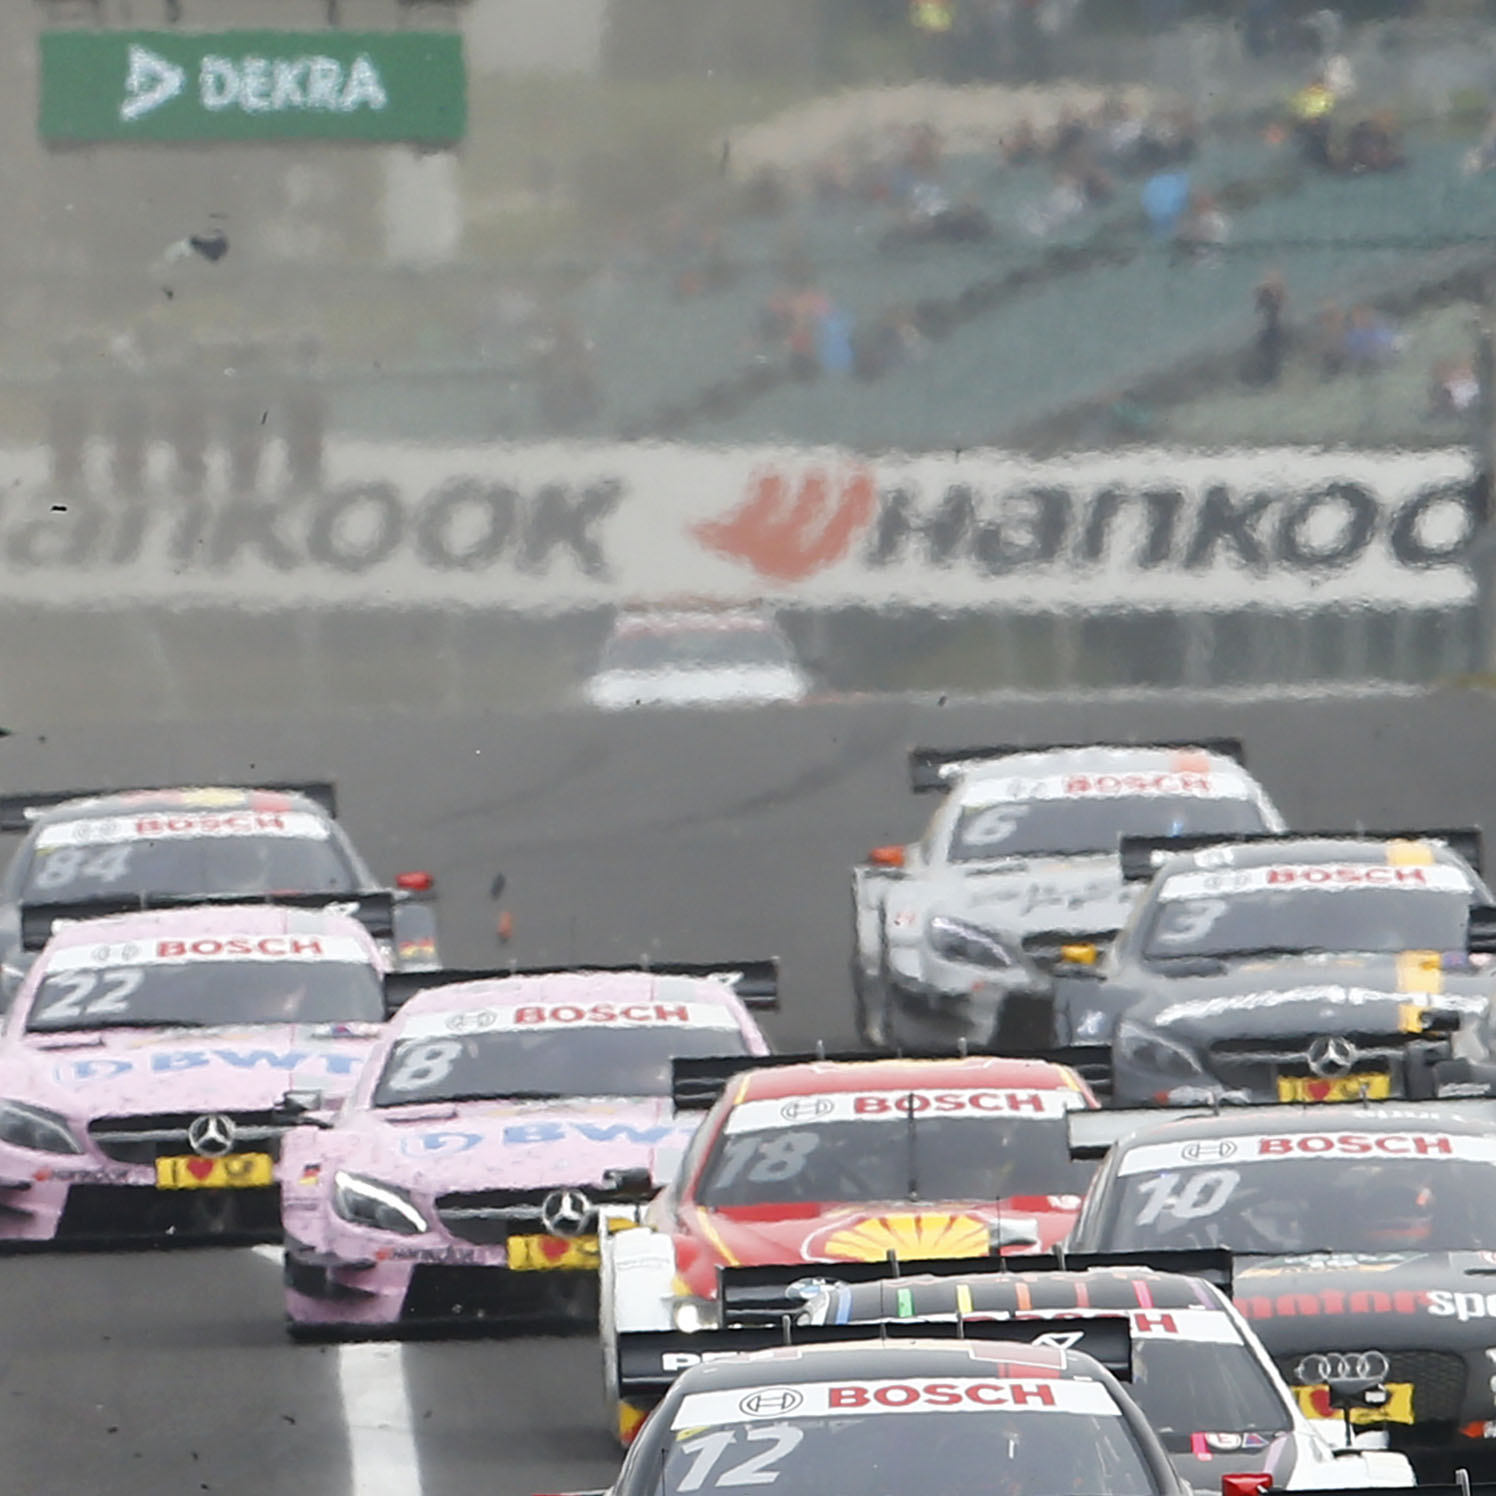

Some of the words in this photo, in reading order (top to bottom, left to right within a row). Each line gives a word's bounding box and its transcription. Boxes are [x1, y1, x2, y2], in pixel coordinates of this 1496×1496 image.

[198, 53, 388, 114] DEKRA
[1062, 772, 1212, 796] BOSCH
[135, 813, 286, 836] BOSCH
[961, 803, 1031, 846] 6
[35, 845, 135, 888] 84
[1265, 866, 1428, 887] BOSCH
[1154, 899, 1231, 946] 3
[155, 937, 324, 959] BOSCH
[34, 968, 147, 1021] 22
[512, 1004, 691, 1026] BOSCH
[149, 1049, 367, 1077] BWT
[389, 1037, 465, 1092] 8
[852, 1092, 1048, 1115] BOSCH
[713, 1130, 821, 1189] 18
[1257, 1135, 1454, 1156] BOSCH
[1136, 1167, 1242, 1228] 10
[828, 1383, 1057, 1408] BOSCH
[675, 1426, 806, 1493] 12
